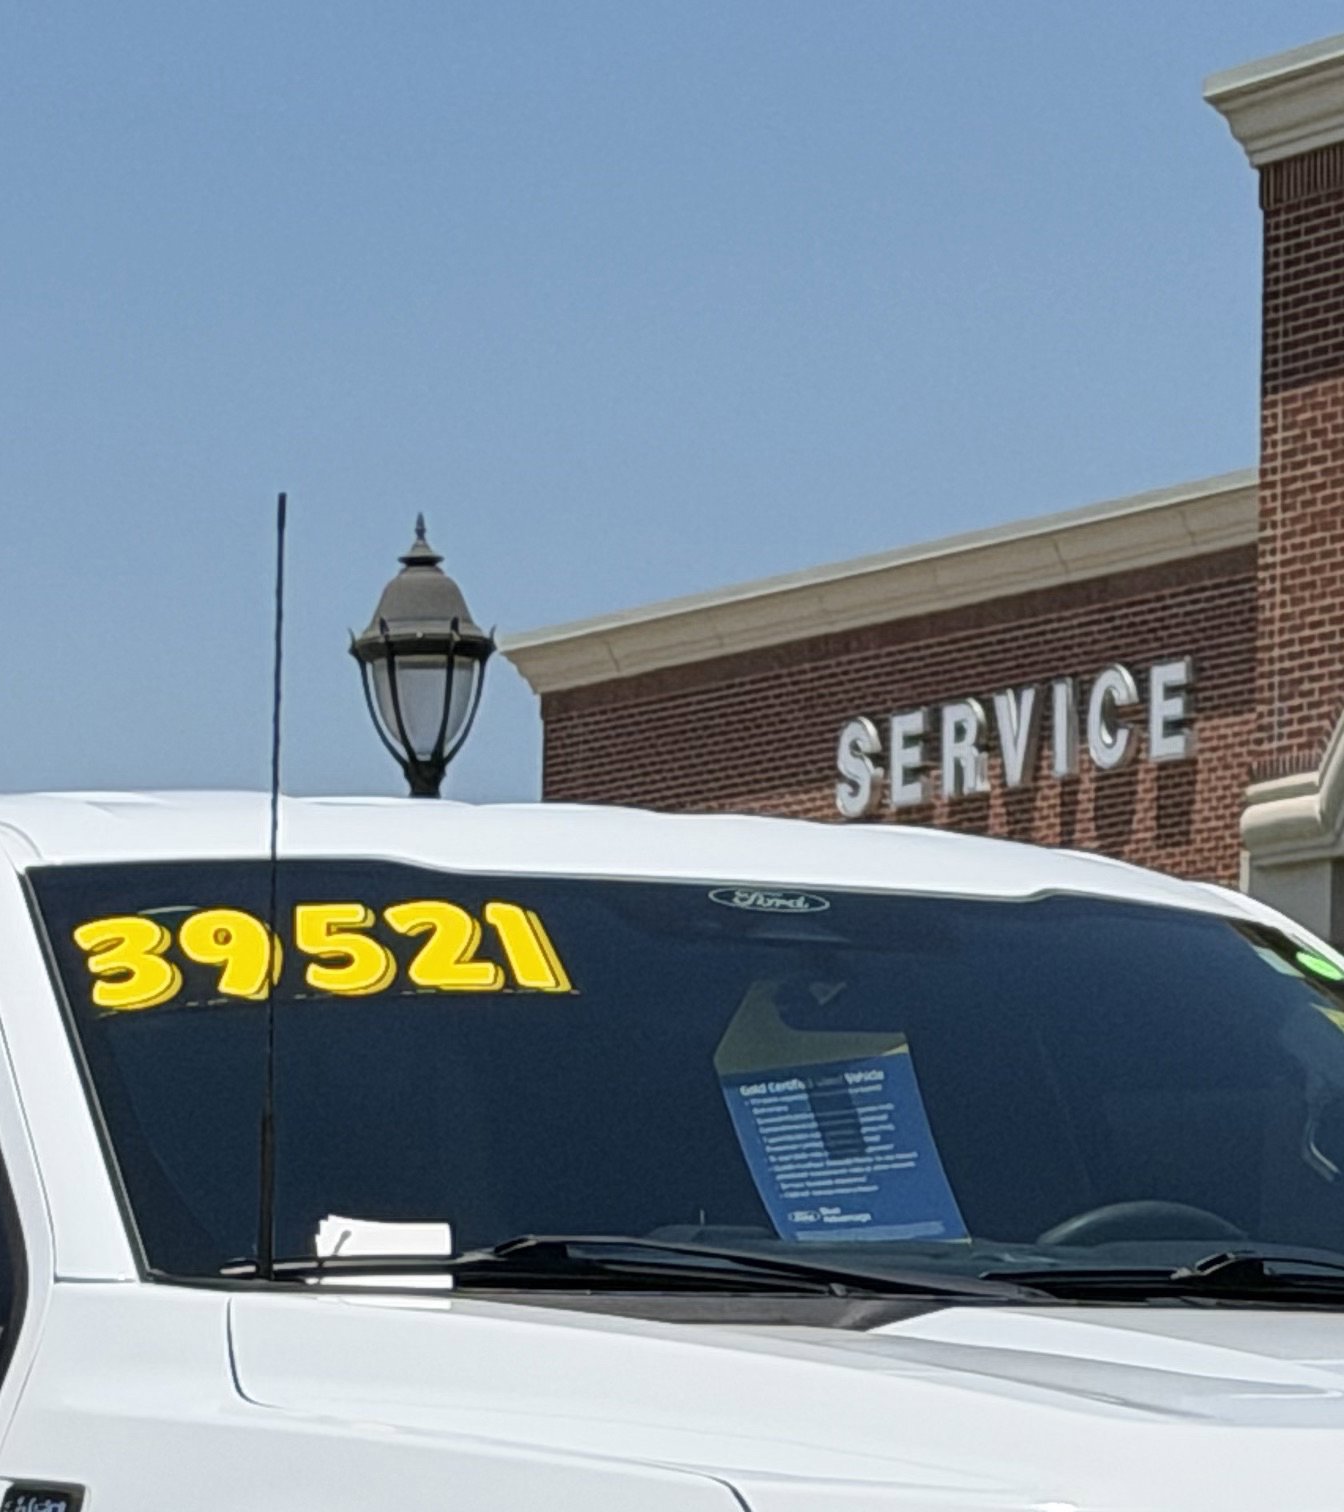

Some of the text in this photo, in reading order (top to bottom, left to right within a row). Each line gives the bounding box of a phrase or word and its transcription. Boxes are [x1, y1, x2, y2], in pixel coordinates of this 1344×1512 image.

[835, 655, 1194, 818] SERVICE
[733, 889, 809, 909] Ford
[72, 900, 573, 1011] 39521
